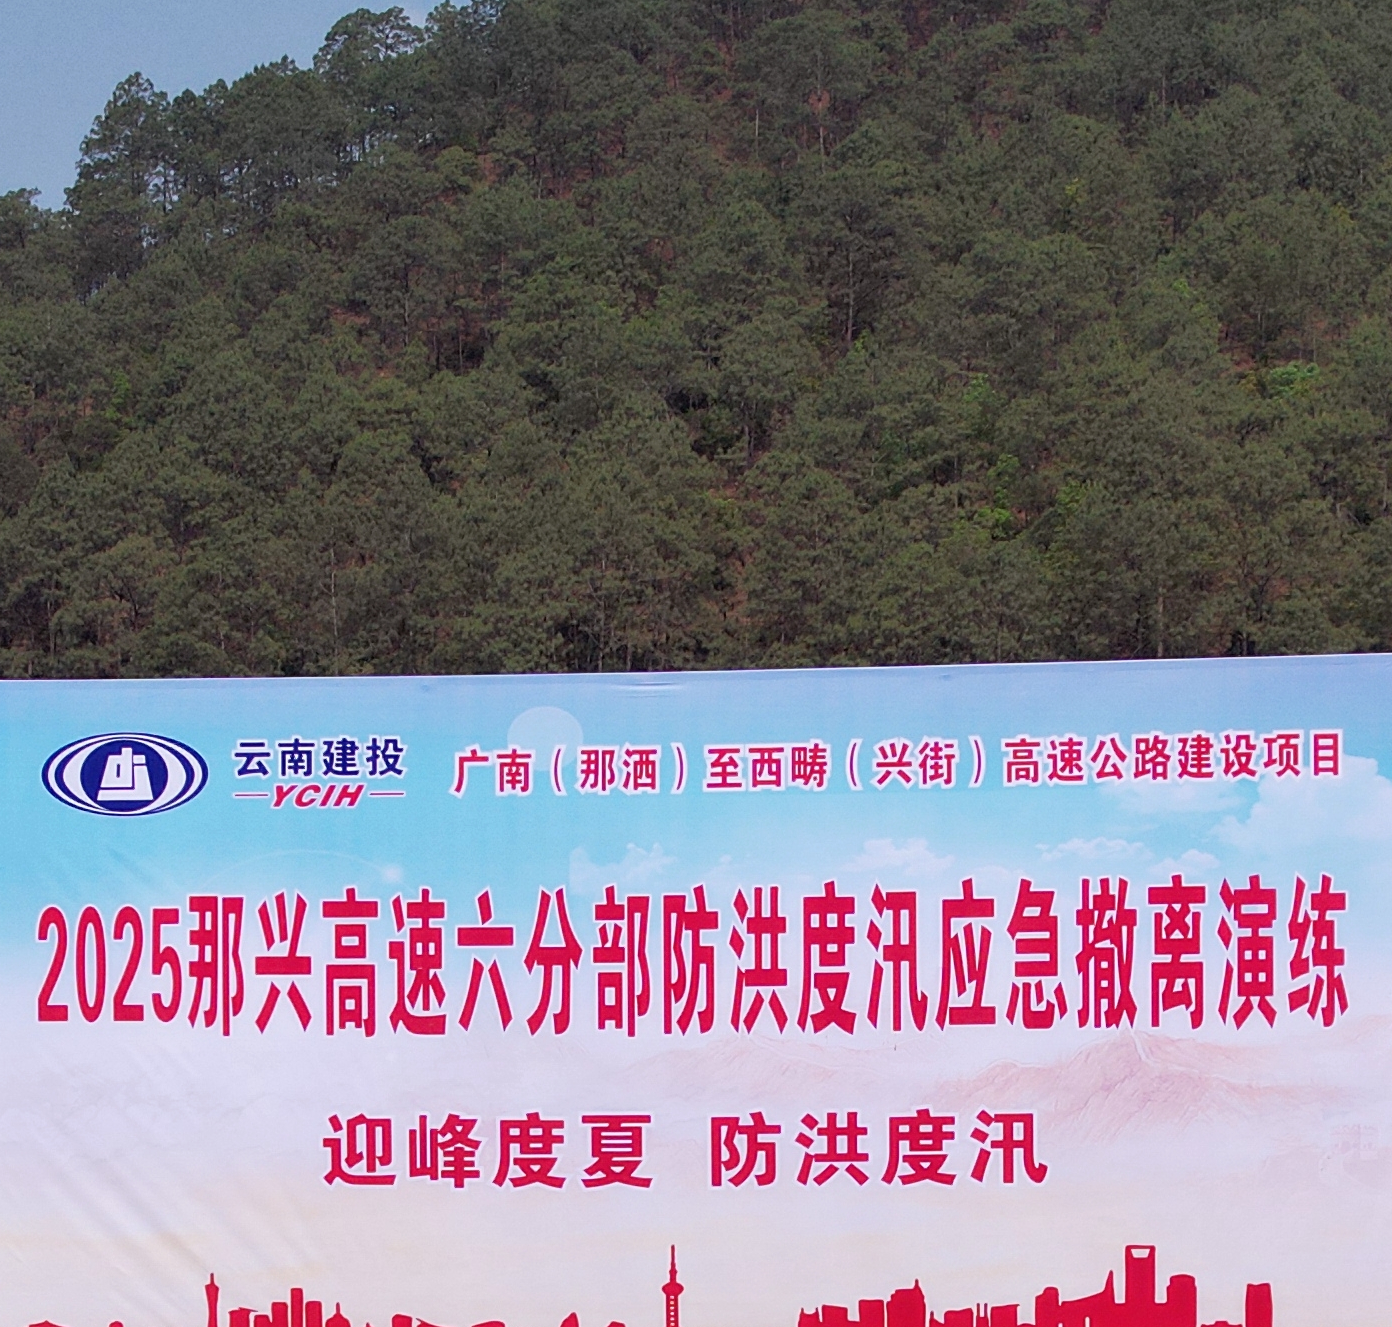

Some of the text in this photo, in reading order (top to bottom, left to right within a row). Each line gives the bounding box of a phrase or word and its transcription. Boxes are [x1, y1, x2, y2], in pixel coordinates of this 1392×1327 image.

[234, 737, 405, 777] 云南建投
[452, 730, 1344, 796] 广南（那洒）至西畴（兴街）高速公路建设项目
[271, 784, 366, 808] YCIH
[36, 873, 1351, 1038] 2025那兴高速六分部防洪度汛应急撤离演练
[321, 1108, 1049, 1190] 迎峰度夏 防洪度汛
